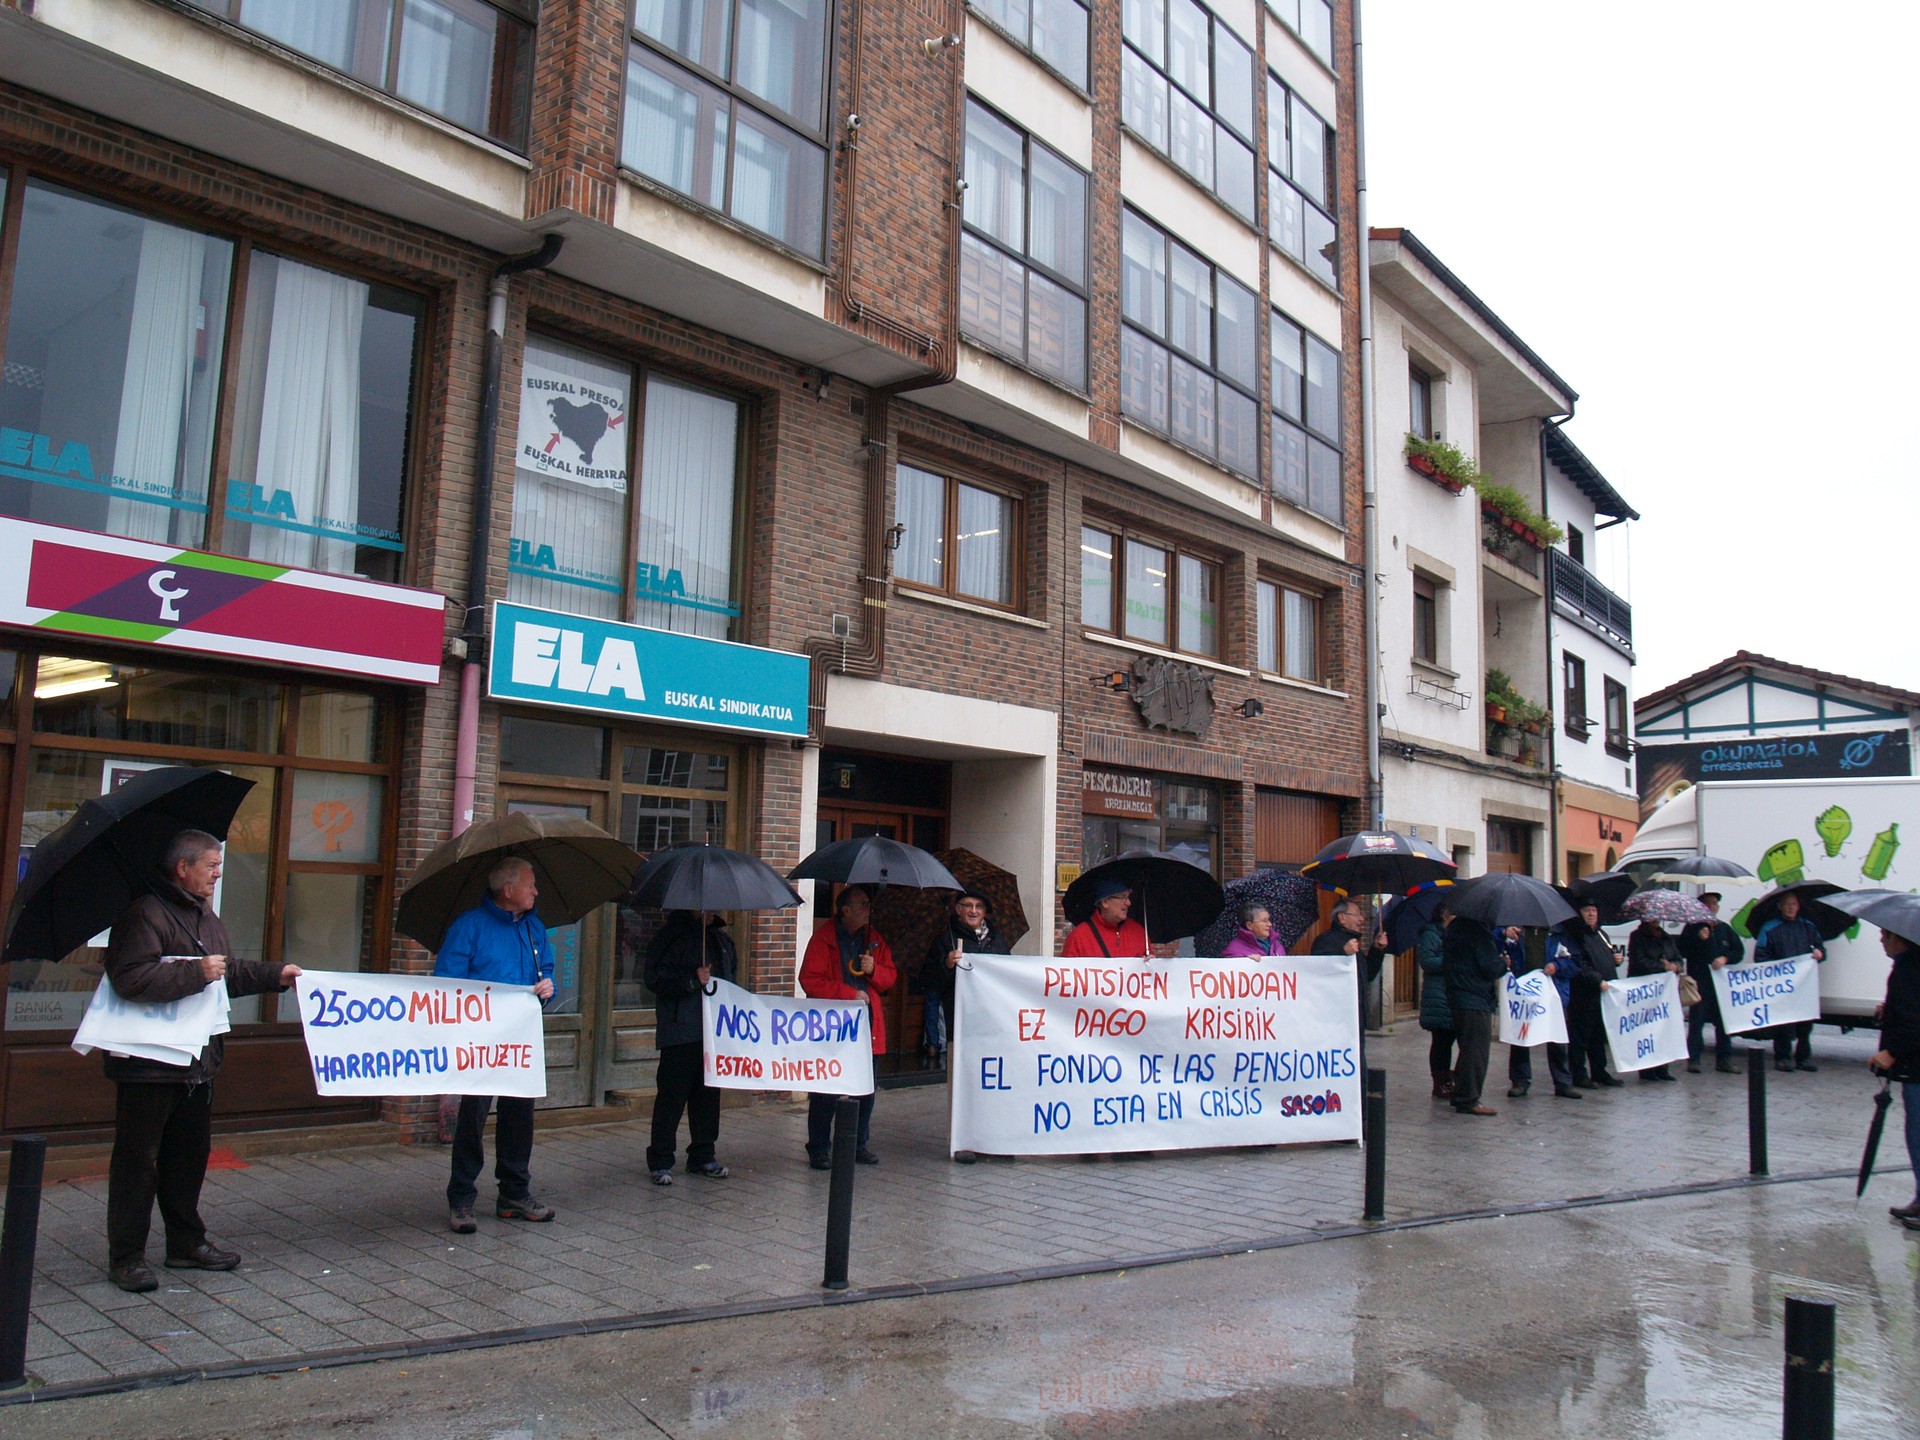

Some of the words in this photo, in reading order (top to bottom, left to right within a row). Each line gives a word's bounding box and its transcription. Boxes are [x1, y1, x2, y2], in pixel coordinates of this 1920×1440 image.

[527, 378, 575, 394] EUSKAL
[1, 426, 95, 480] ELA
[524, 445, 571, 473] EUSKAL
[576, 465, 627, 480] HERRIRA
[99, 473, 140, 489] EUSKAL
[144, 482, 204, 501] SINDIKATUA
[225, 479, 297, 519] ELA
[313, 515, 347, 529] EUSKAL
[350, 523, 401, 541] SINDIKATUA
[559, 565, 583, 576] EUSKAL
[637, 562, 685, 597] ELA
[512, 621, 646, 701] ELA
[665, 690, 715, 711] EUSKAL
[719, 698, 793, 721] SINDIKATUA
[1083, 771, 1152, 798] PESCADERIA
[563, 929, 576, 988] EUSKAL
[1728, 960, 1796, 988] PENSIONES
[1044, 967, 1168, 1000] PENTSIOEN
[1189, 970, 1297, 1001] FONDOAN
[13, 1014, 64, 1023] ASEGURUAK
[14, 1001, 62, 1014] BANKA
[309, 988, 406, 1028] 25.000
[408, 986, 492, 1025] MILIOI
[1018, 1009, 1046, 1041] EZ
[1075, 1008, 1146, 1038] DAGO
[1185, 1006, 1277, 1041] KRISIRIK
[716, 1004, 761, 1043] NOS
[771, 1009, 862, 1045] ROBAN
[315, 1046, 448, 1083] HARRAPATU
[456, 1041, 532, 1071] DITUZTE
[1637, 1034, 1654, 1058] BAI
[772, 1057, 842, 1081] DINERO
[981, 1056, 1012, 1090] EL
[1038, 1054, 1122, 1087] FONDO
[1140, 1054, 1164, 1084] DE
[1174, 1054, 1216, 1083] LAS
[1233, 1048, 1356, 1083] PENSIONES
[1034, 1101, 1071, 1134] NO
[1094, 1094, 1145, 1126] ESTA
[1157, 1090, 1182, 1121] EN
[1200, 1086, 1262, 1117] CRISIS
[1280, 1089, 1342, 1117] SASOIA
